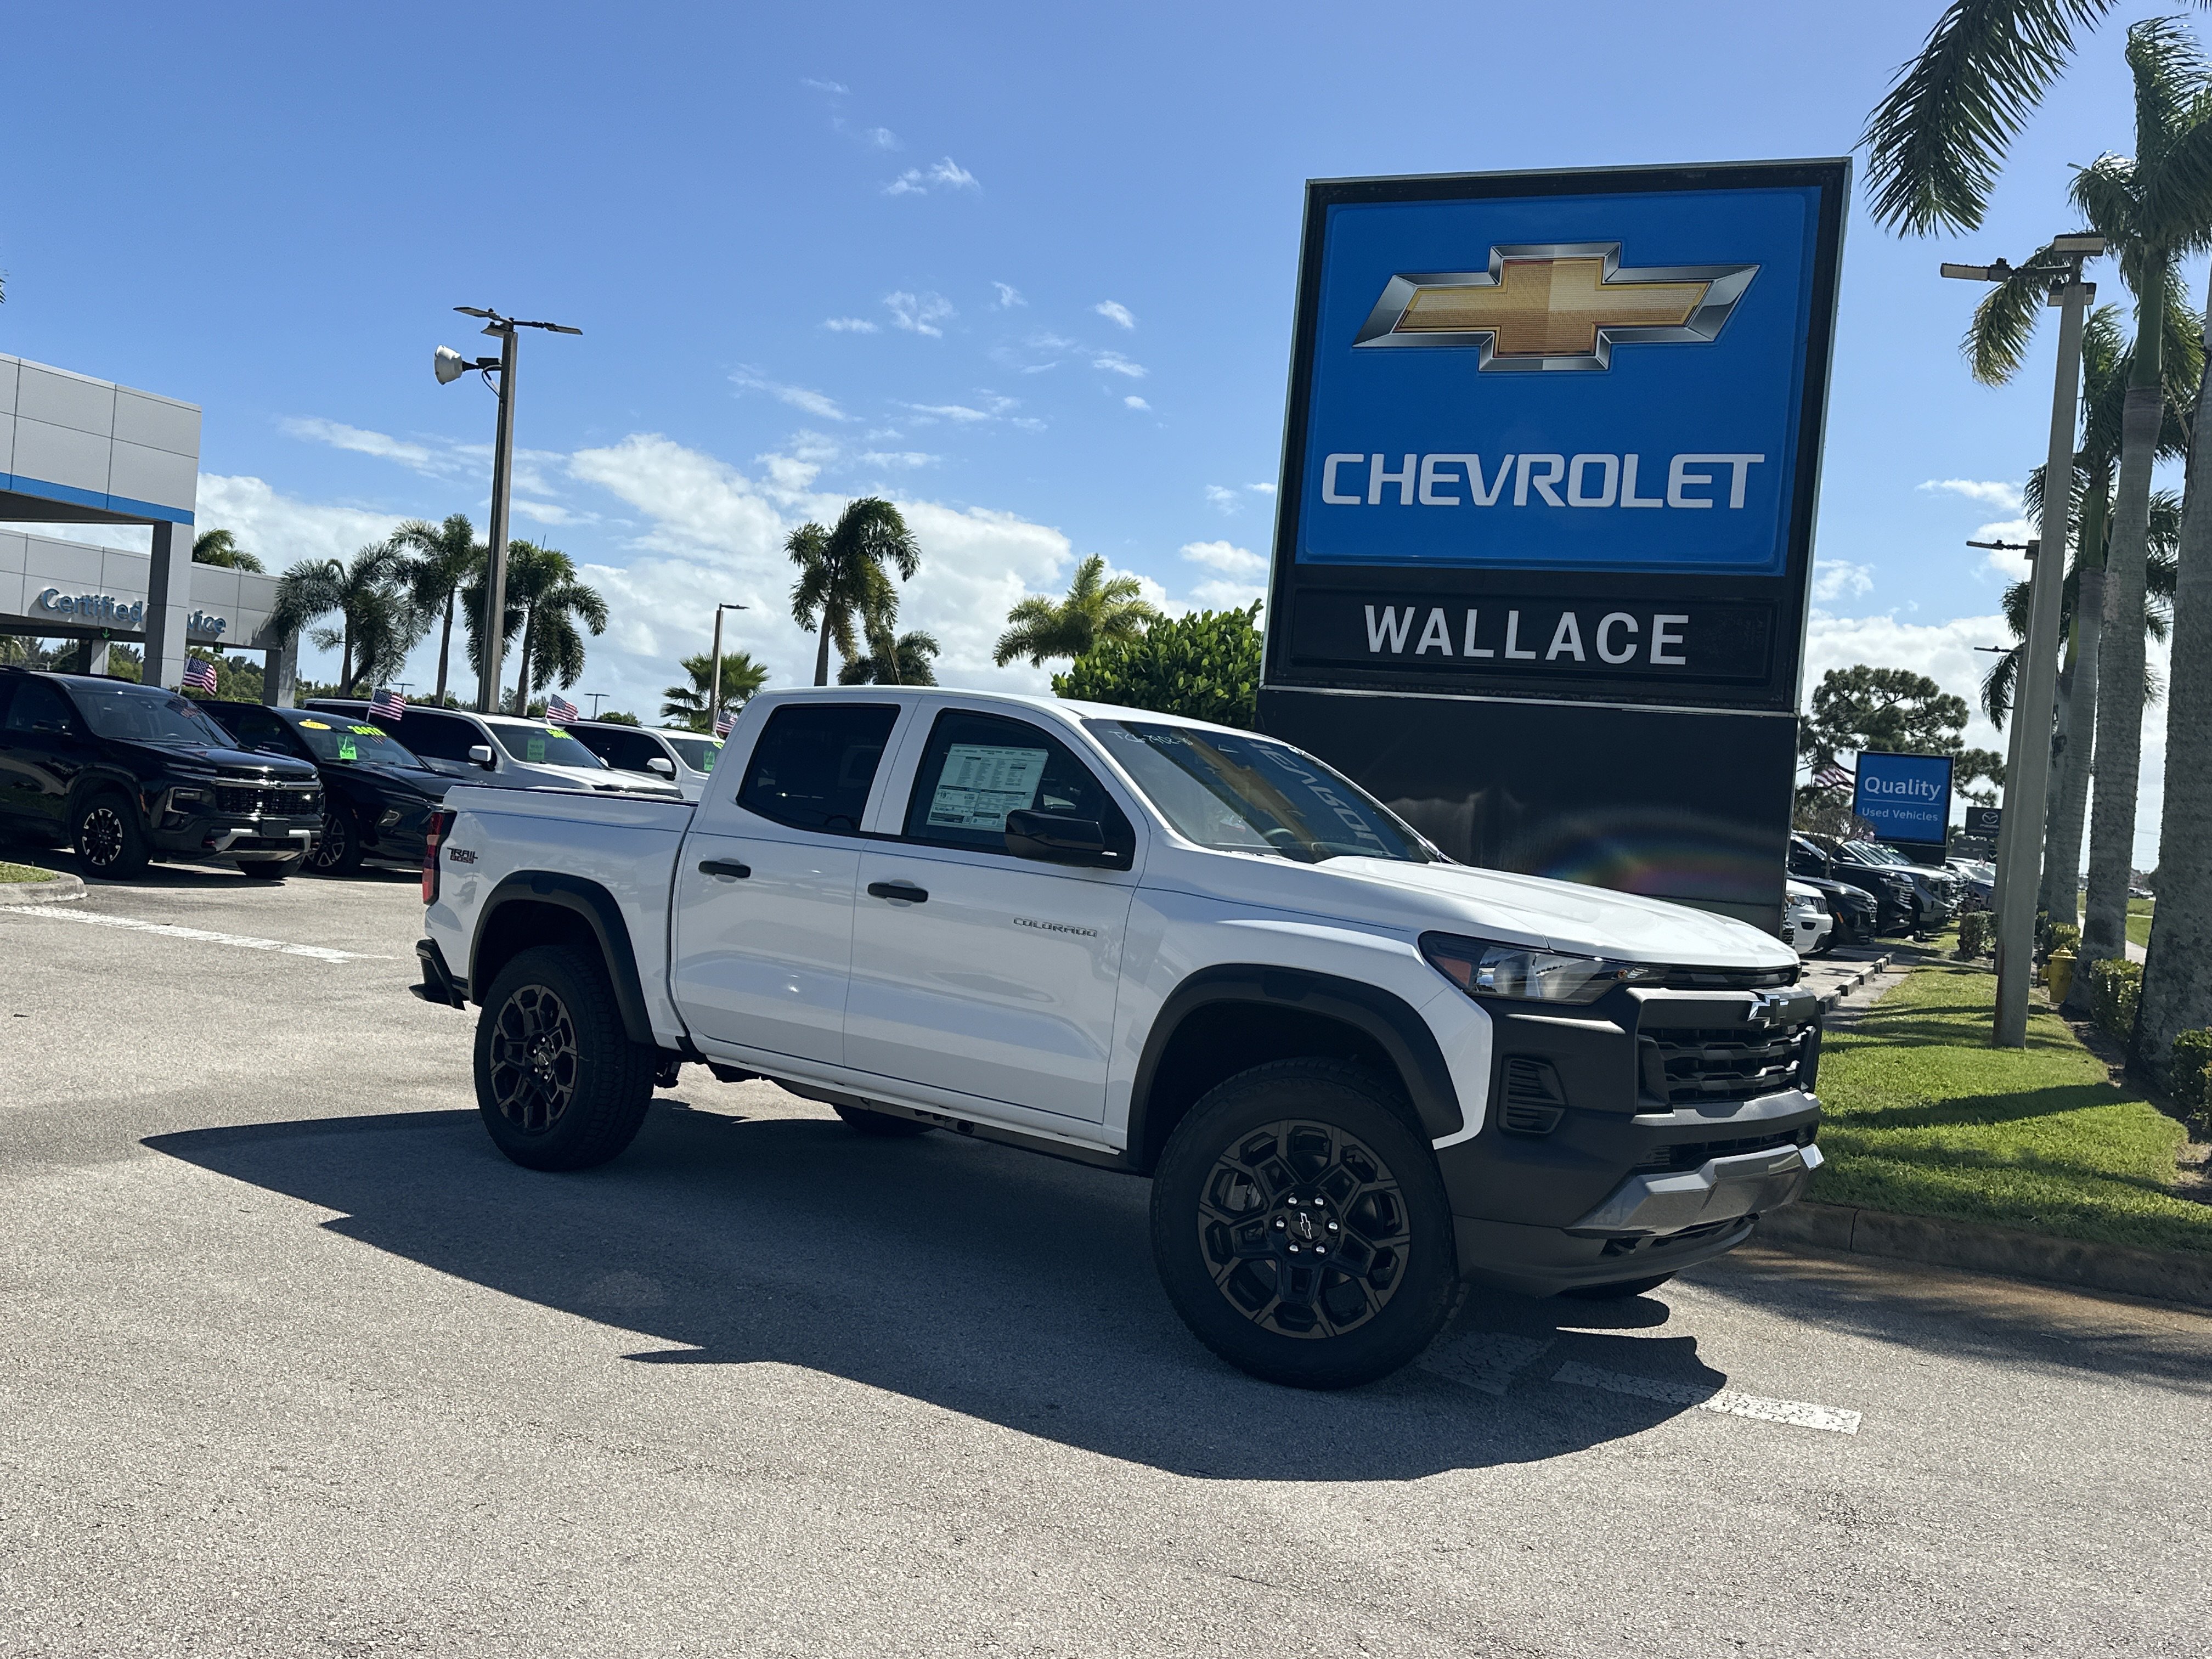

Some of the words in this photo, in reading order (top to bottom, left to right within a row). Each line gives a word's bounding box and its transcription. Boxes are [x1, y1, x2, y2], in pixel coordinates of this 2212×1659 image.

[1322, 453, 1765, 509] CHEVROLET
[42, 588, 143, 623] Certified
[187, 610, 226, 634] vice
[1364, 604, 1690, 665] WALLACE
[1864, 776, 1942, 802] Quality
[1861, 807, 1889, 818] Used
[1893, 809, 1939, 822] Vehicles
[447, 847, 479, 859] TRAIL
[450, 855, 475, 864] BOSS
[1013, 917, 1098, 938] COLORADO
